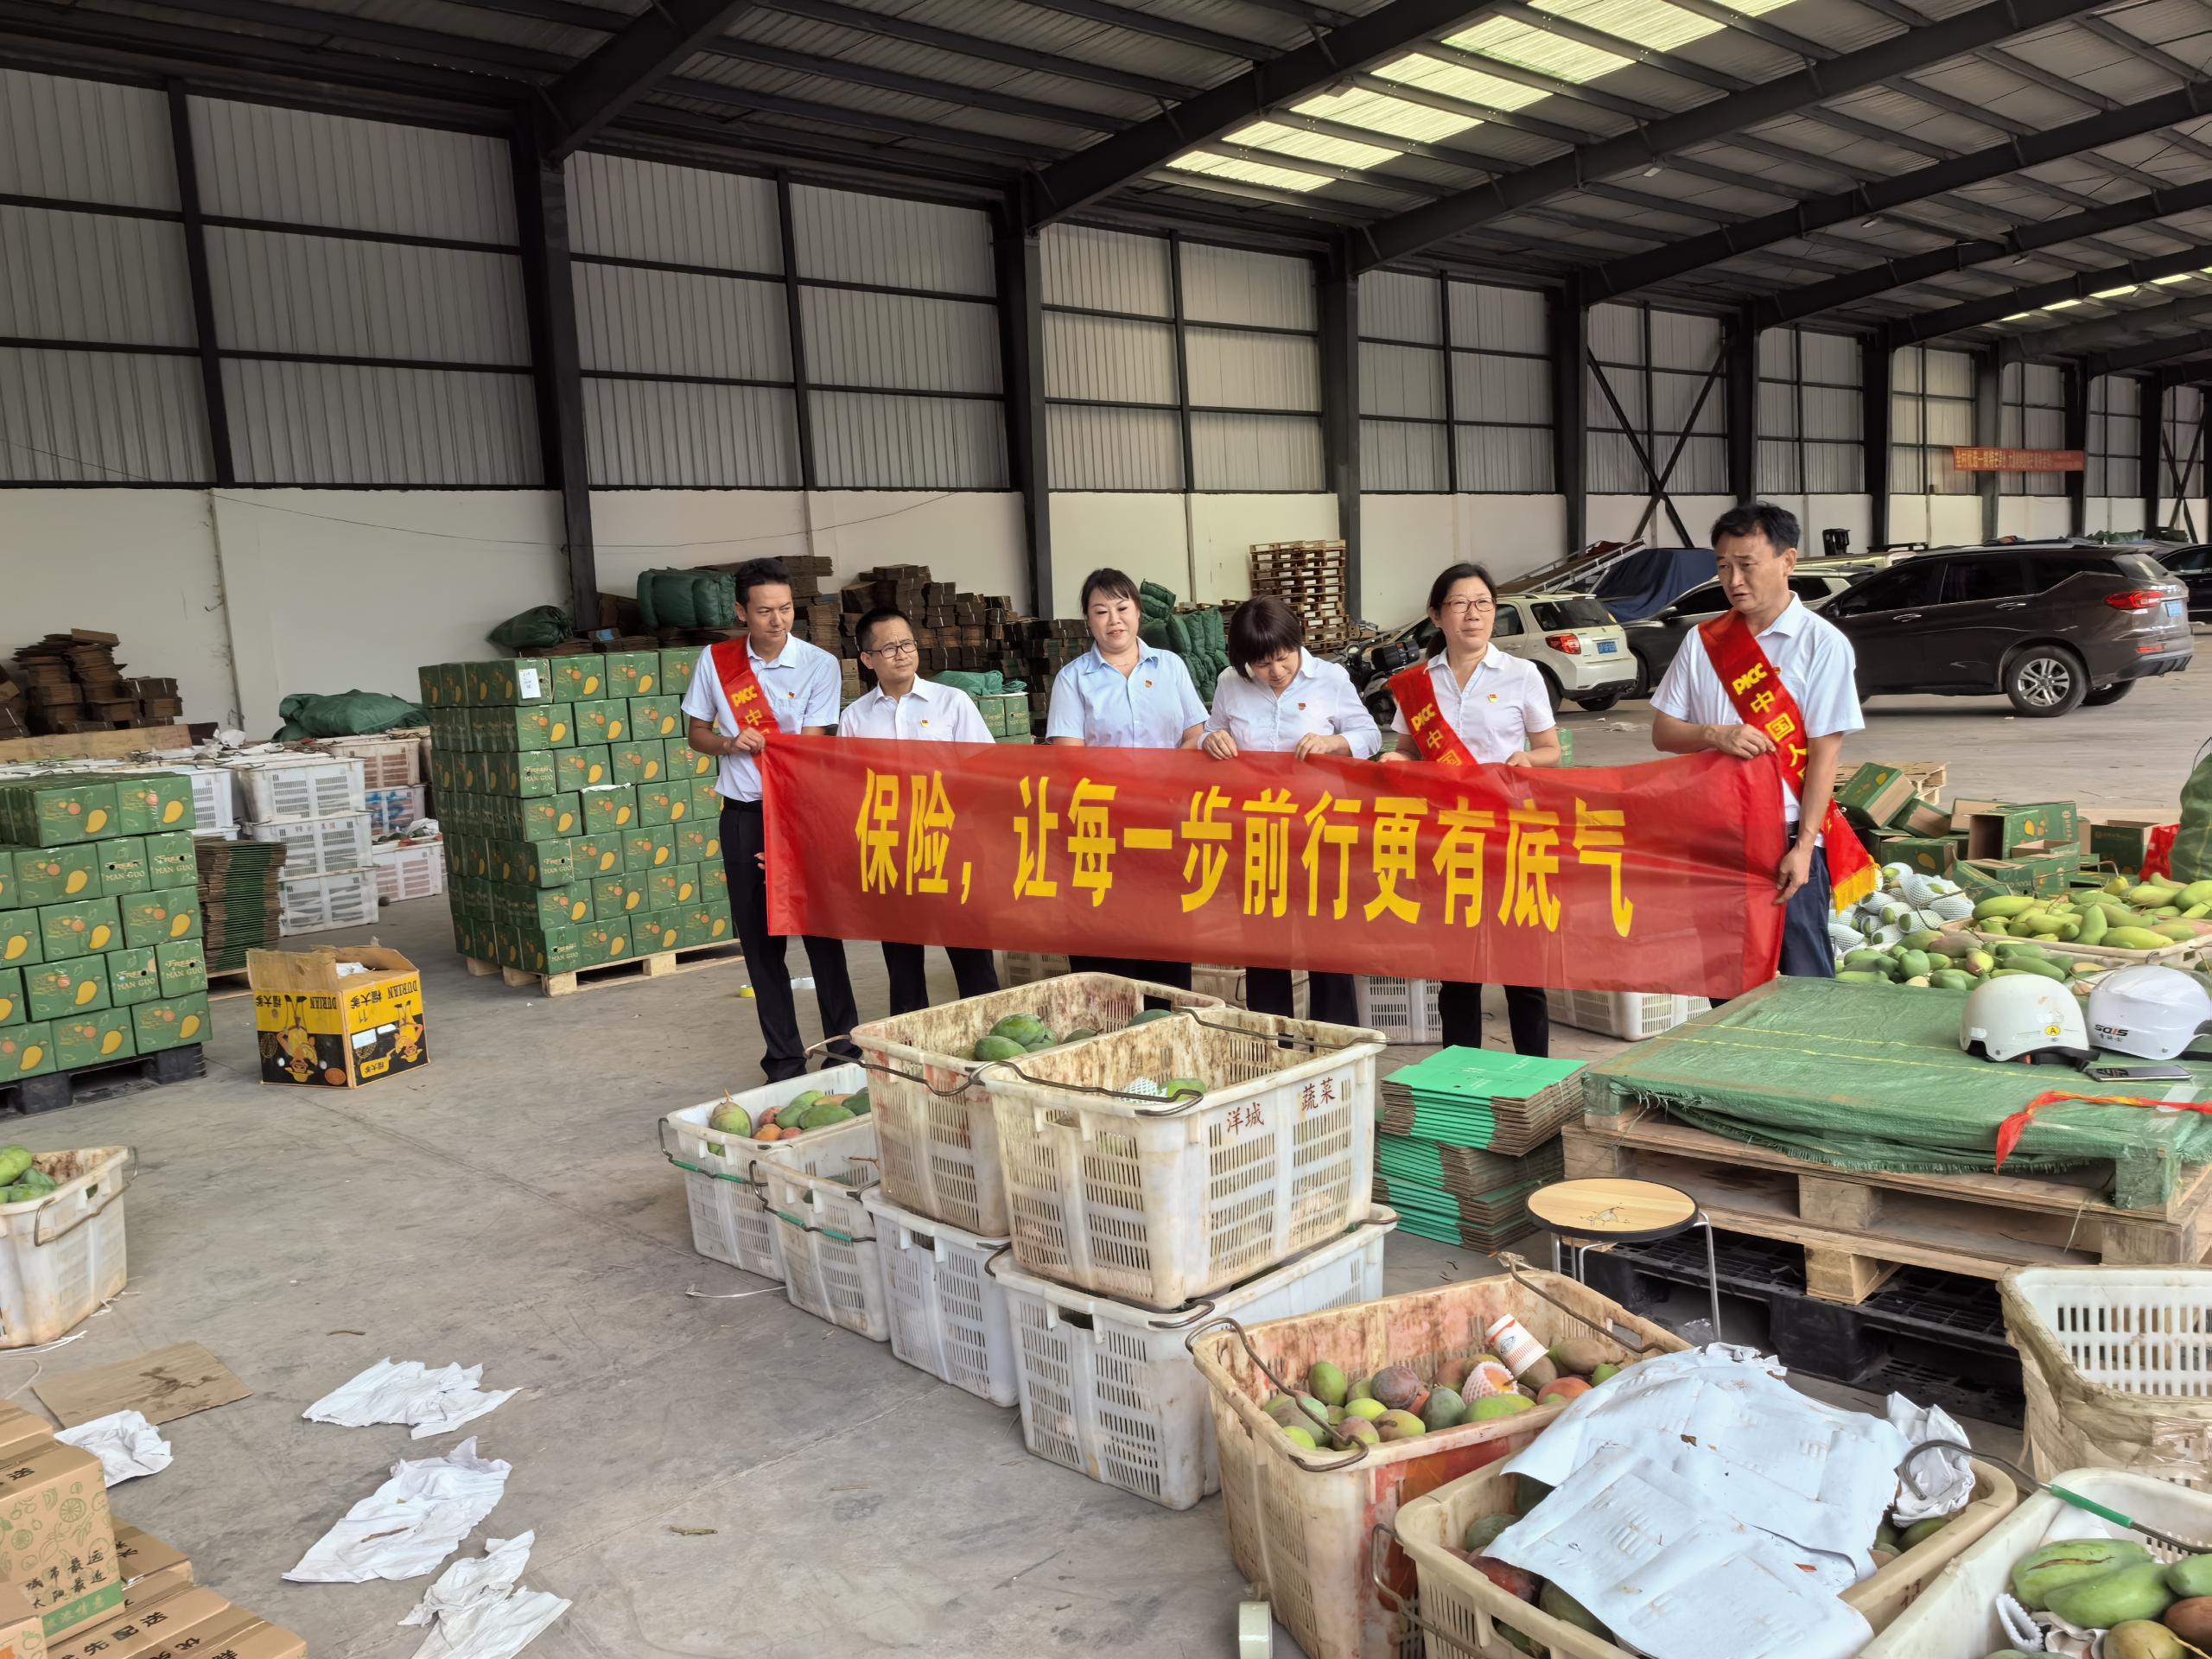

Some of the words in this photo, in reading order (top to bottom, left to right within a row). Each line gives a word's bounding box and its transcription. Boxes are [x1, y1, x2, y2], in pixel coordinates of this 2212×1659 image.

[1732, 663, 1768, 696] PICC
[731, 685, 758, 707] PICC
[1411, 703, 1436, 732] PICC
[855, 767, 1634, 938] 保险，让每一步前行更有底气
[105, 872, 125, 881] MAN
[126, 870, 145, 879] GUO
[155, 866, 174, 874] MAN
[166, 970, 185, 980] MAN
[186, 966, 203, 976] GUO
[118, 982, 136, 990] MAN
[137, 977, 156, 986] GUO
[388, 980, 418, 1000] DURIAN
[309, 996, 337, 1009] DURIAN
[1227, 1102, 1264, 1135] 洋城
[1301, 1077, 1336, 1112] 蔬菜
